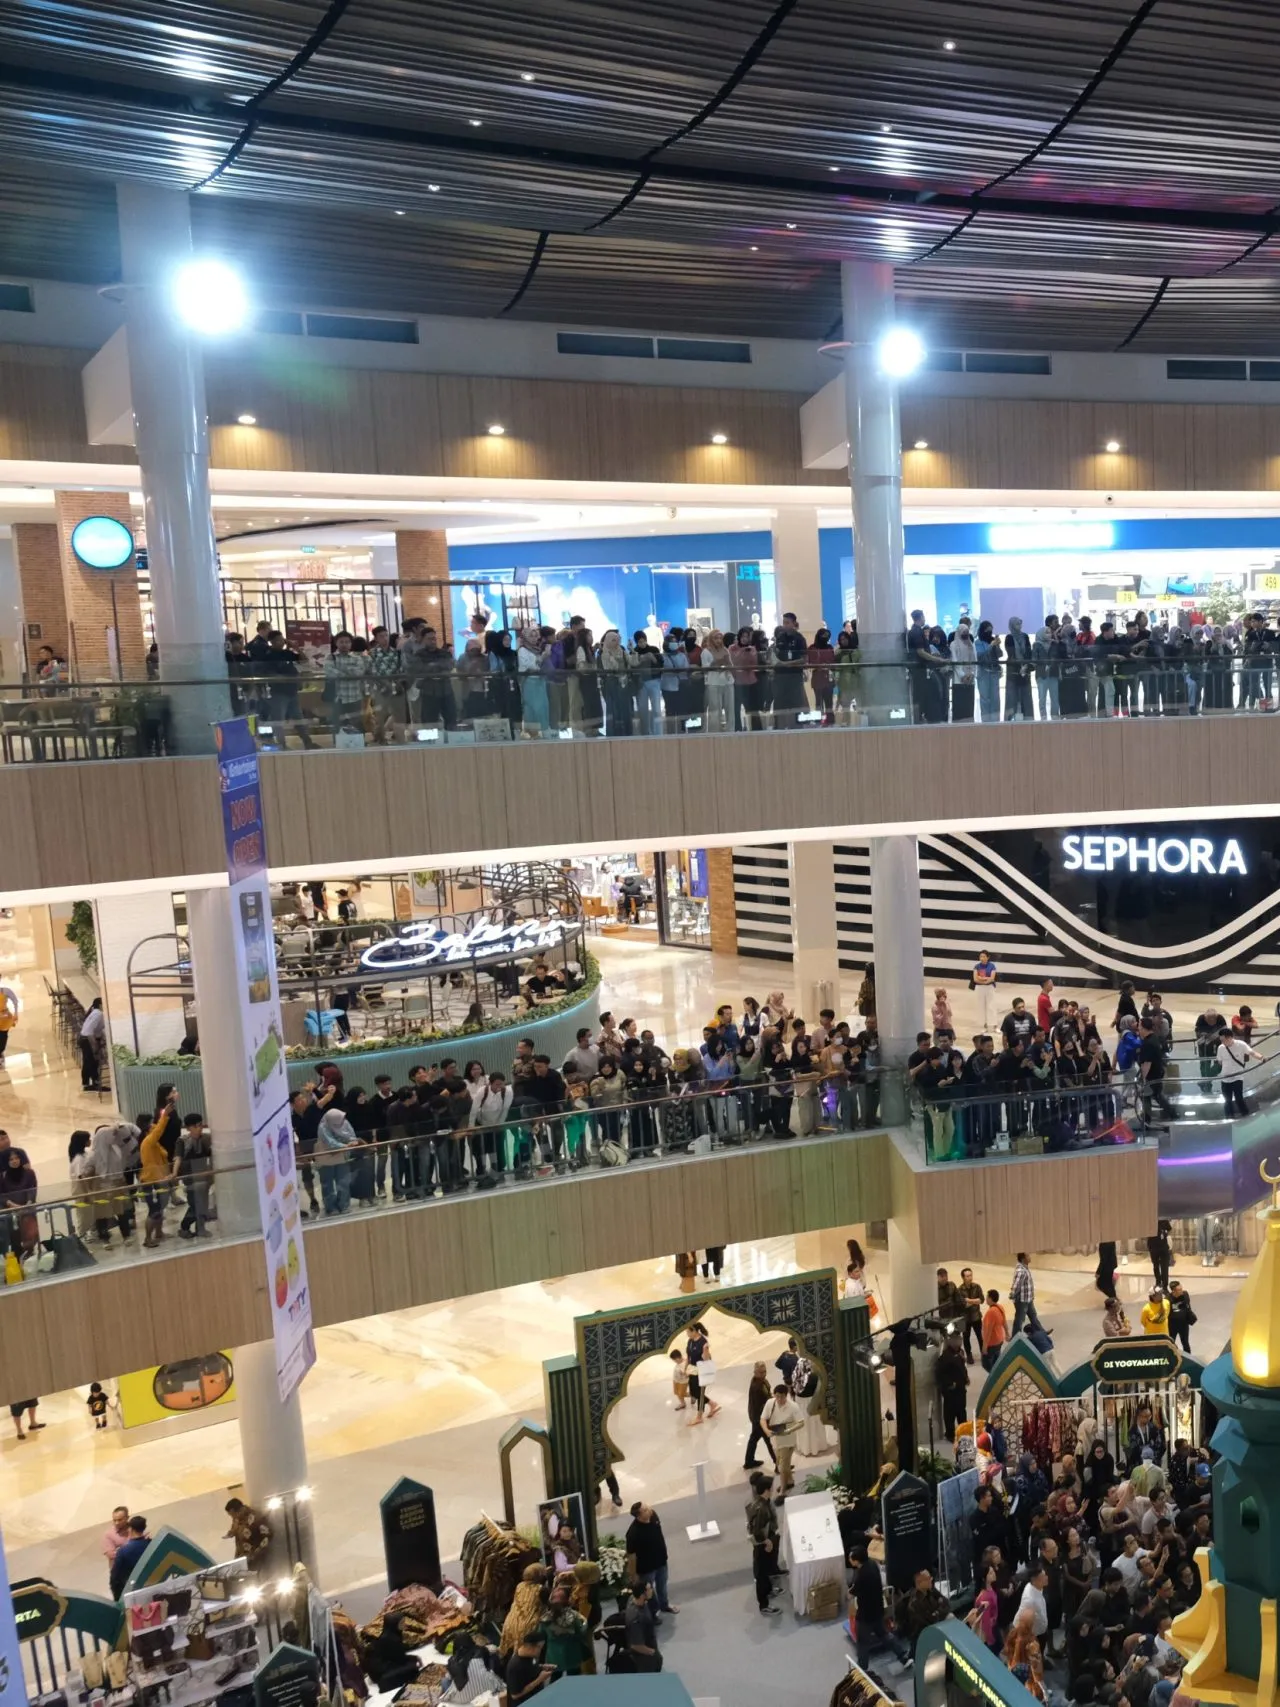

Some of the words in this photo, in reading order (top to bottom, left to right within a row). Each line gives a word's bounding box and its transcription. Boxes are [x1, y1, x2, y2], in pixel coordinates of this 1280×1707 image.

[1062, 834, 1248, 876] SEPHORA
[1103, 1361, 1114, 1369] DI
[1114, 1357, 1170, 1368] YOGYAKARTA
